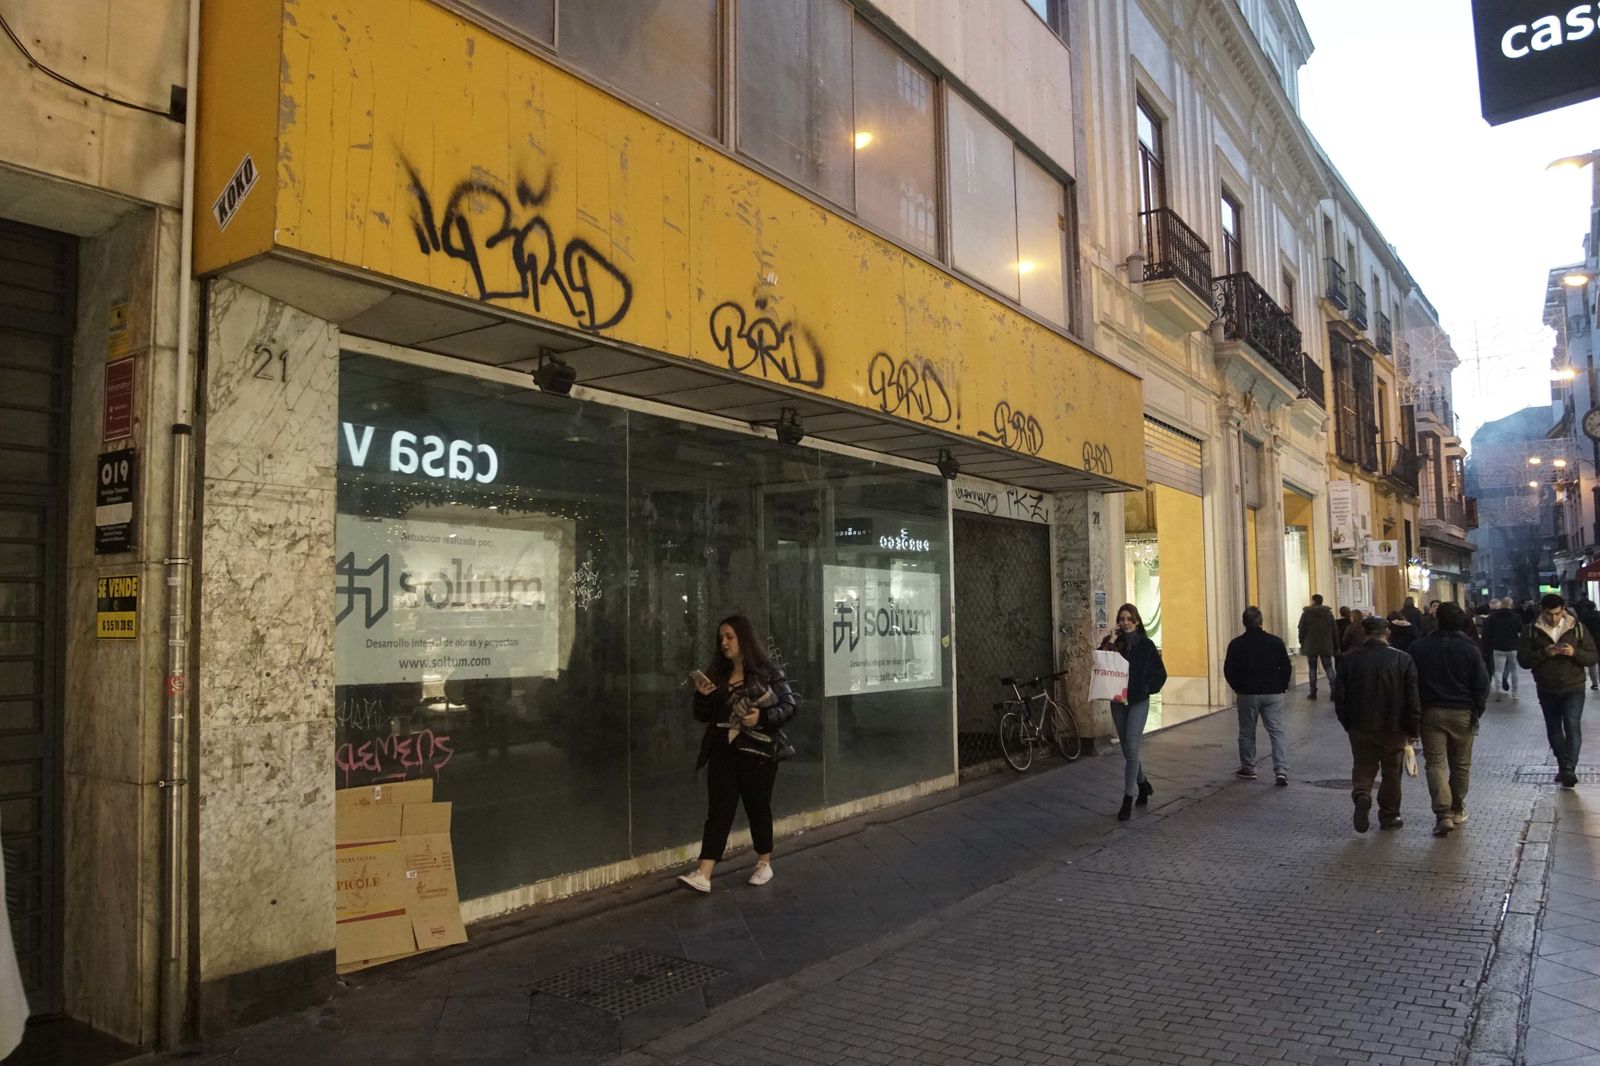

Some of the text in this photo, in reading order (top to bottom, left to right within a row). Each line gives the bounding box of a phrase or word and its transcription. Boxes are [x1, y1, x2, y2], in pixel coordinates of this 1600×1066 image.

[1501, 2, 1600, 58] cas
[217, 158, 254, 224] KOKO
[252, 344, 289, 384] 21
[101, 460, 129, 485] 019
[98, 576, 138, 599] SE VENDE
[366, 638, 410, 649] Desarrollo
[444, 637, 453, 648] de
[454, 638, 477, 648] obras
[478, 640, 483, 649] y
[399, 656, 491, 669] www.soltum.com
